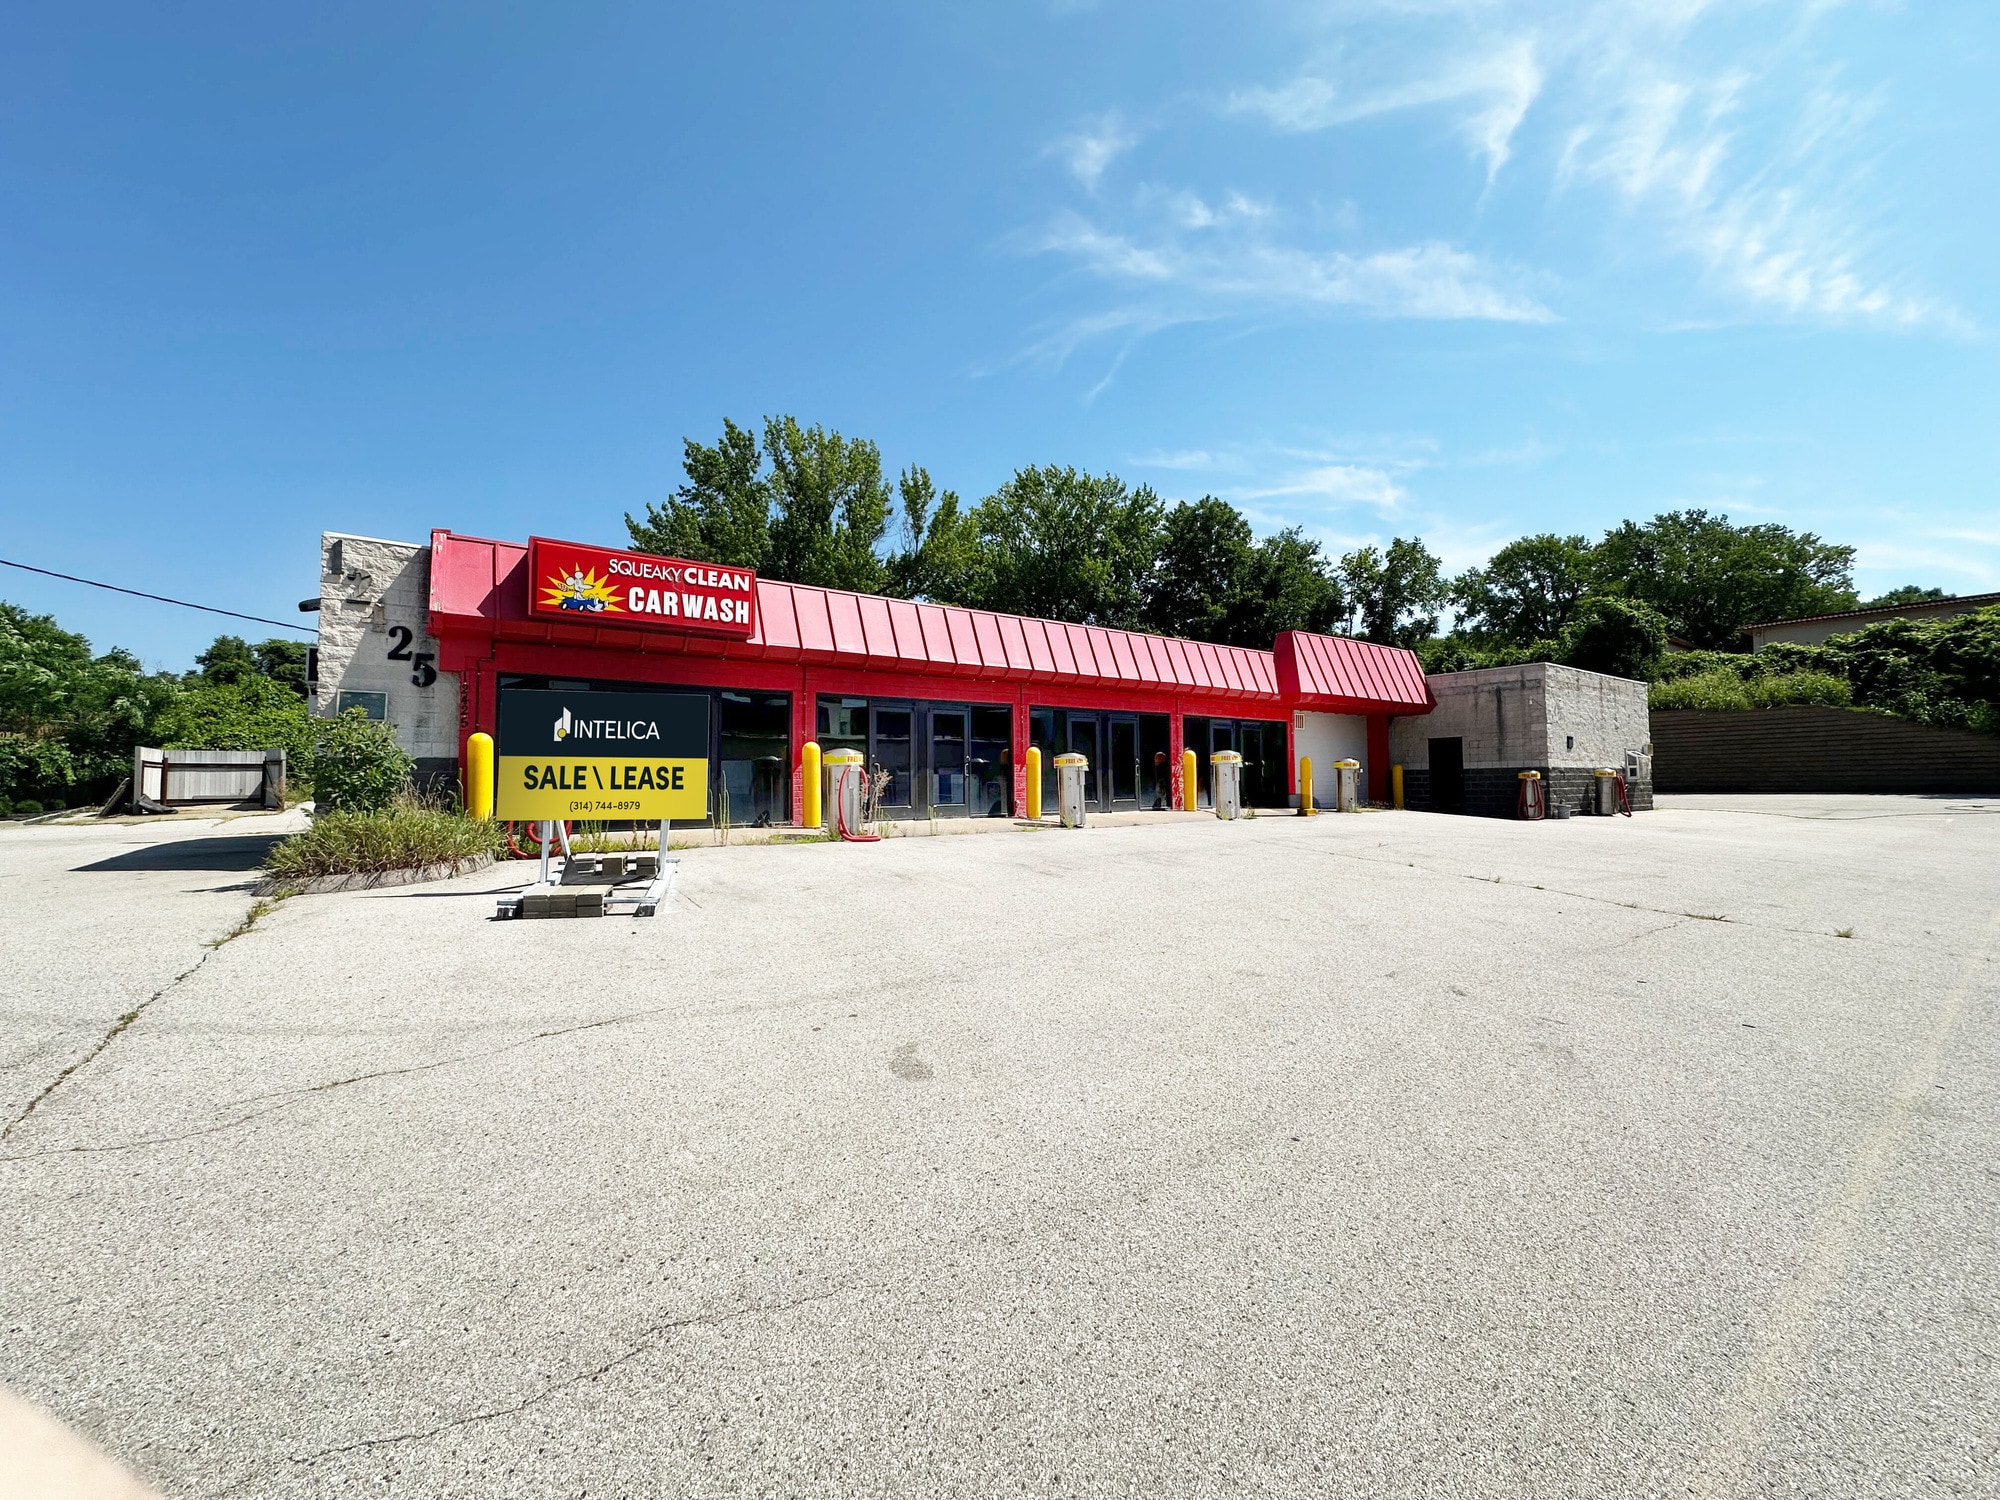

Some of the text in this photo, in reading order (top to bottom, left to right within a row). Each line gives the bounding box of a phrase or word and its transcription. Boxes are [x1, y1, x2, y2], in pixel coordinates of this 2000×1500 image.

[608, 558, 749, 592] SQUEAKY CLEAN
[628, 586, 749, 624] CAR WASH
[574, 719, 660, 740] INTELICA
[523, 765, 587, 790] SALE
[610, 766, 685, 790] LEASE
[569, 801, 640, 812] (314) 744-8979
